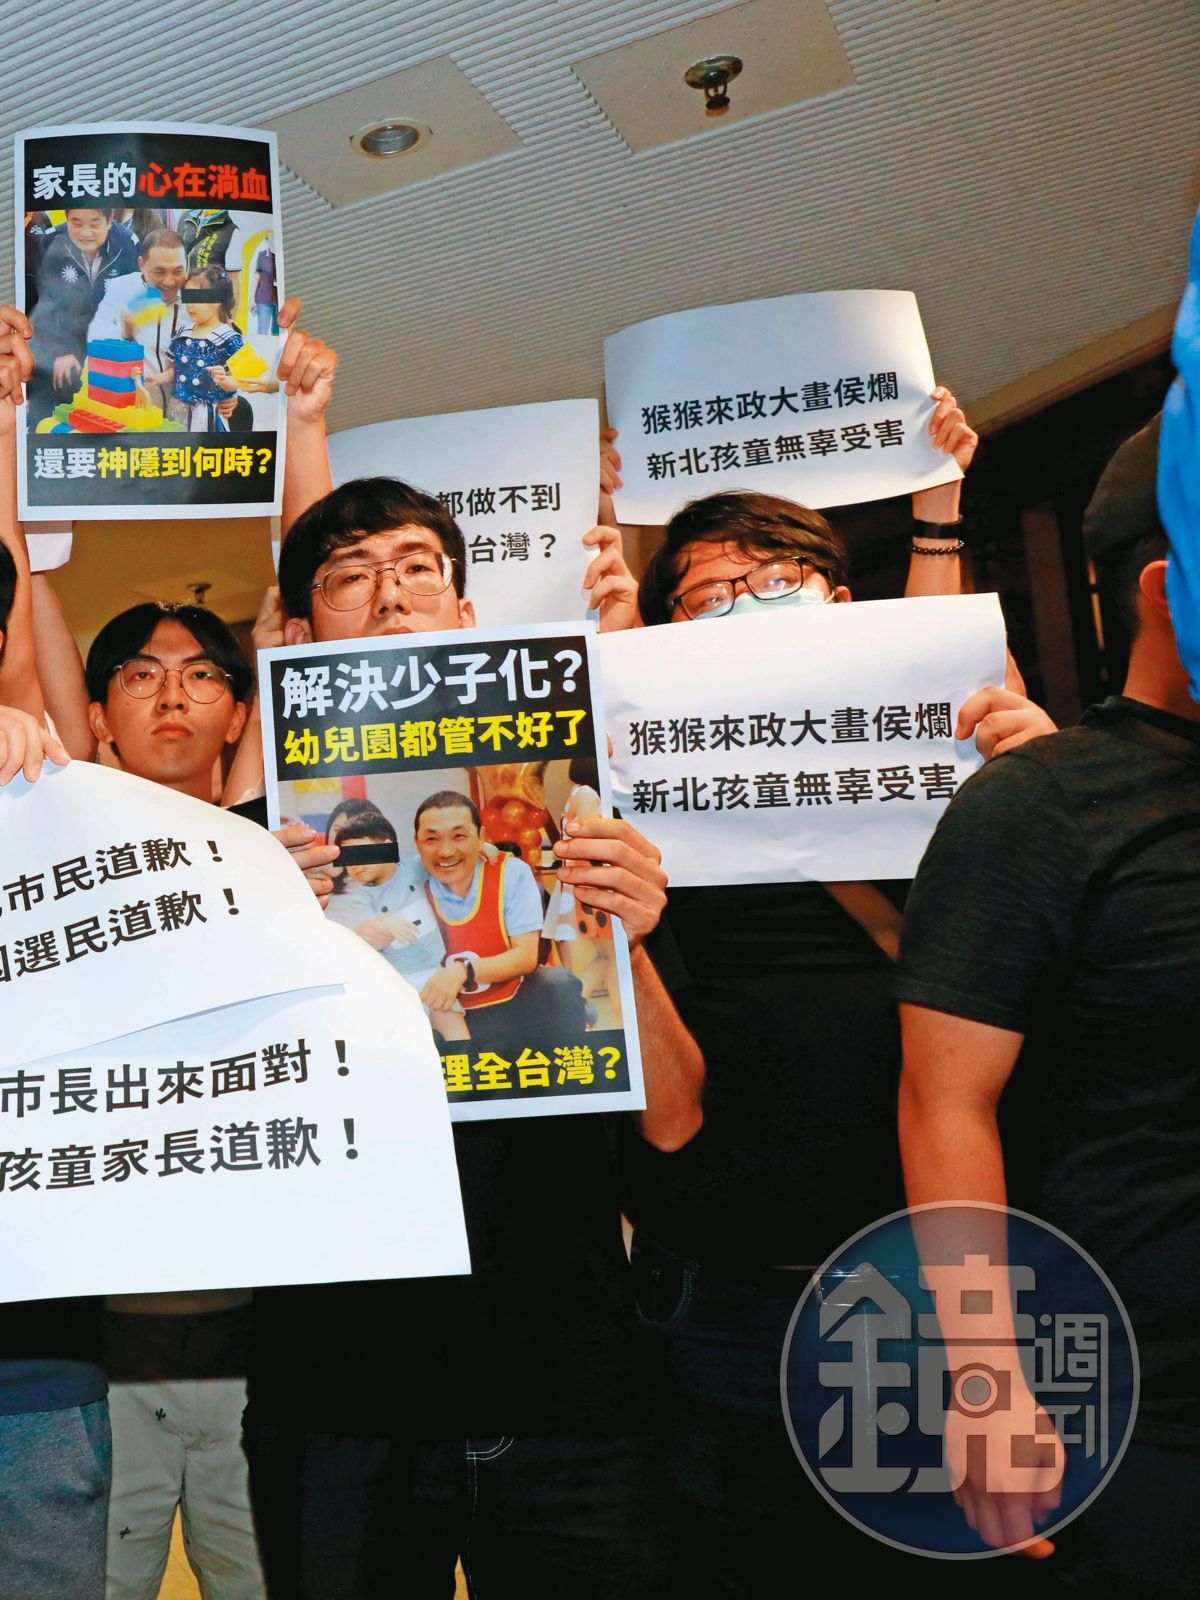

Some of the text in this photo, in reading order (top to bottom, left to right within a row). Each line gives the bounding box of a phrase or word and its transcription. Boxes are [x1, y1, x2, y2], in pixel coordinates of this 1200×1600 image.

[32, 162, 271, 202] 家長的心在淌血
[641, 372, 898, 435] 猴猴來政大畫侯爛
[34, 446, 272, 479] 還要神隱到何時?
[647, 419, 905, 480] 新北孩童無辜受害
[468, 533, 557, 564] 台灣？
[280, 648, 583, 719] 解決少子化?
[284, 709, 587, 766] 幼兒園都管不好了
[630, 702, 952, 756] 猴猴來政大畫侯爛
[632, 763, 958, 814] 新北孩童無辜受害
[441, 1046, 621, 1092] 理全台灣?
